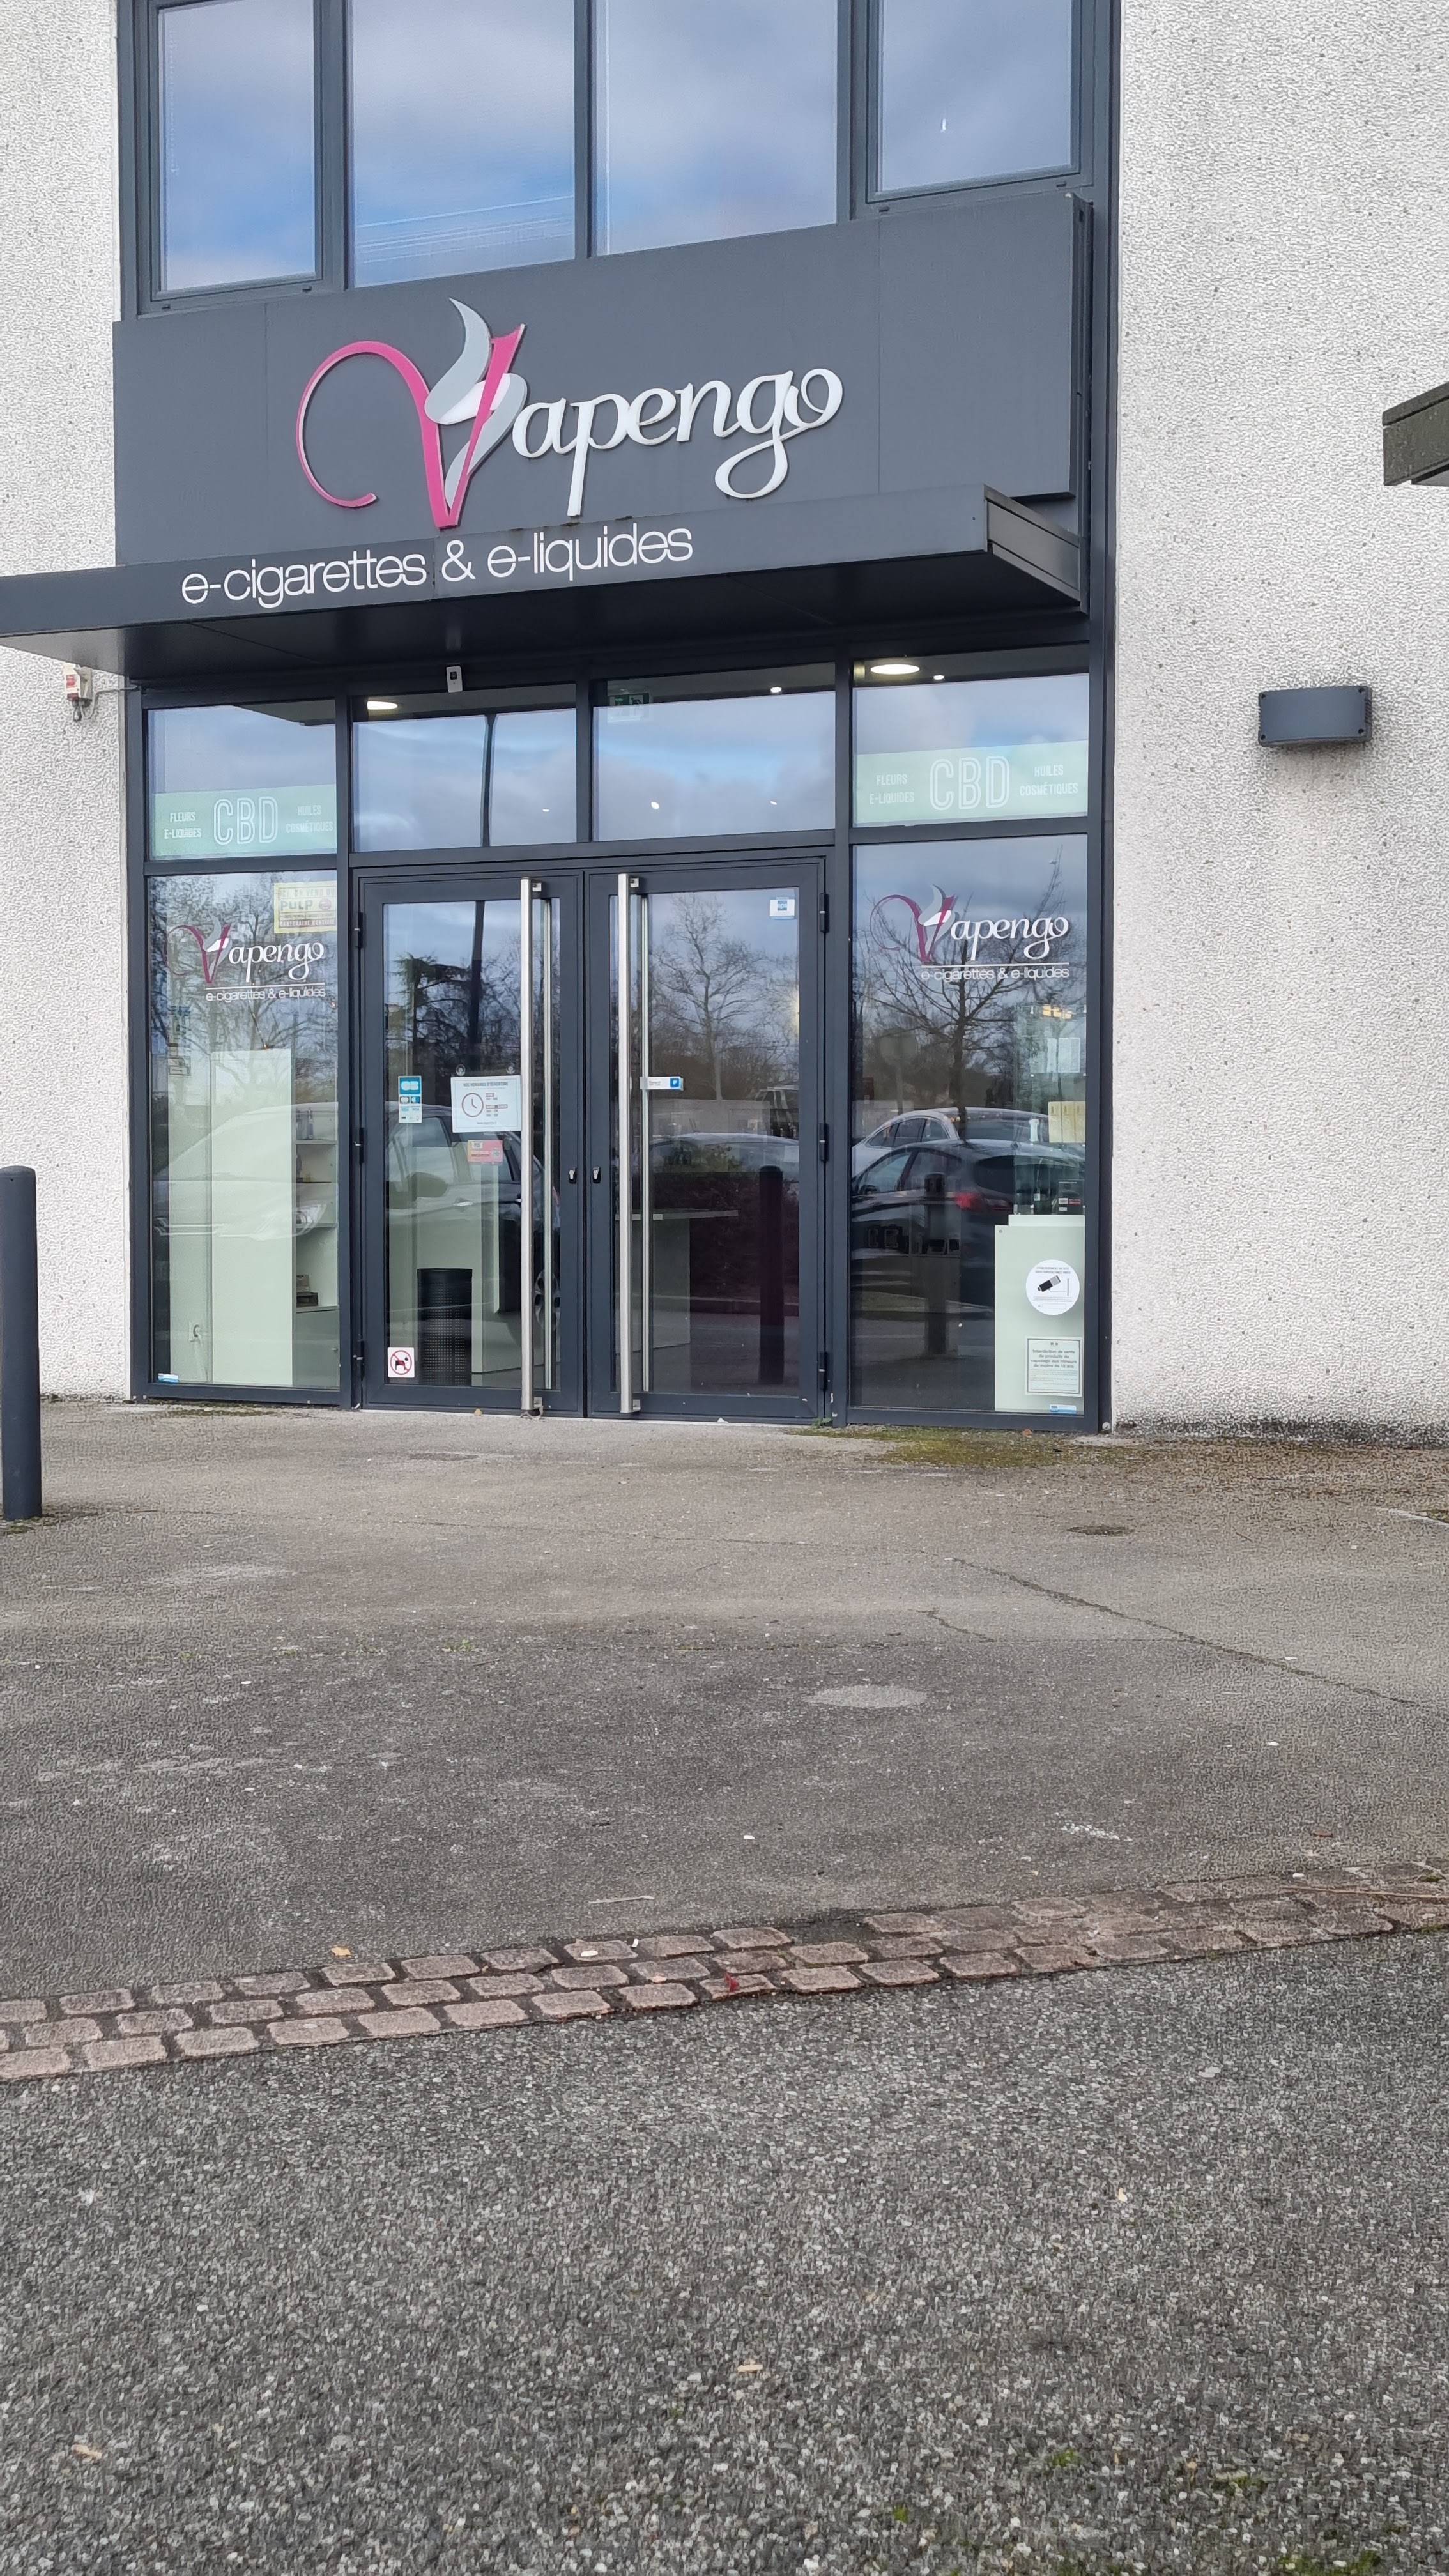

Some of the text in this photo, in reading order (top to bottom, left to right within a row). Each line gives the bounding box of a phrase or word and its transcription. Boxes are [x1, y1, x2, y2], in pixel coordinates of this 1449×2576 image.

[295, 322, 843, 529] Vapengo
[181, 523, 693, 608] e-cigarettes & e-liquides
[1034, 765, 1064, 778] HUILES
[876, 774, 908, 786] FLEURS
[930, 755, 1010, 811] CBD
[1020, 781, 1078, 797] COSMÉTIQUES
[869, 792, 915, 805] E-LIQUIDES
[298, 805, 322, 816] HUILES
[213, 796, 279, 845] CBD
[280, 900, 313, 911] PULP
[870, 894, 1069, 963] Vapengo
[164, 923, 325, 985] Vapengo
[921, 967, 1070, 983] e-cigarettes & e-liquides
[206, 986, 326, 1003] e-cigarettes & e-liquides
